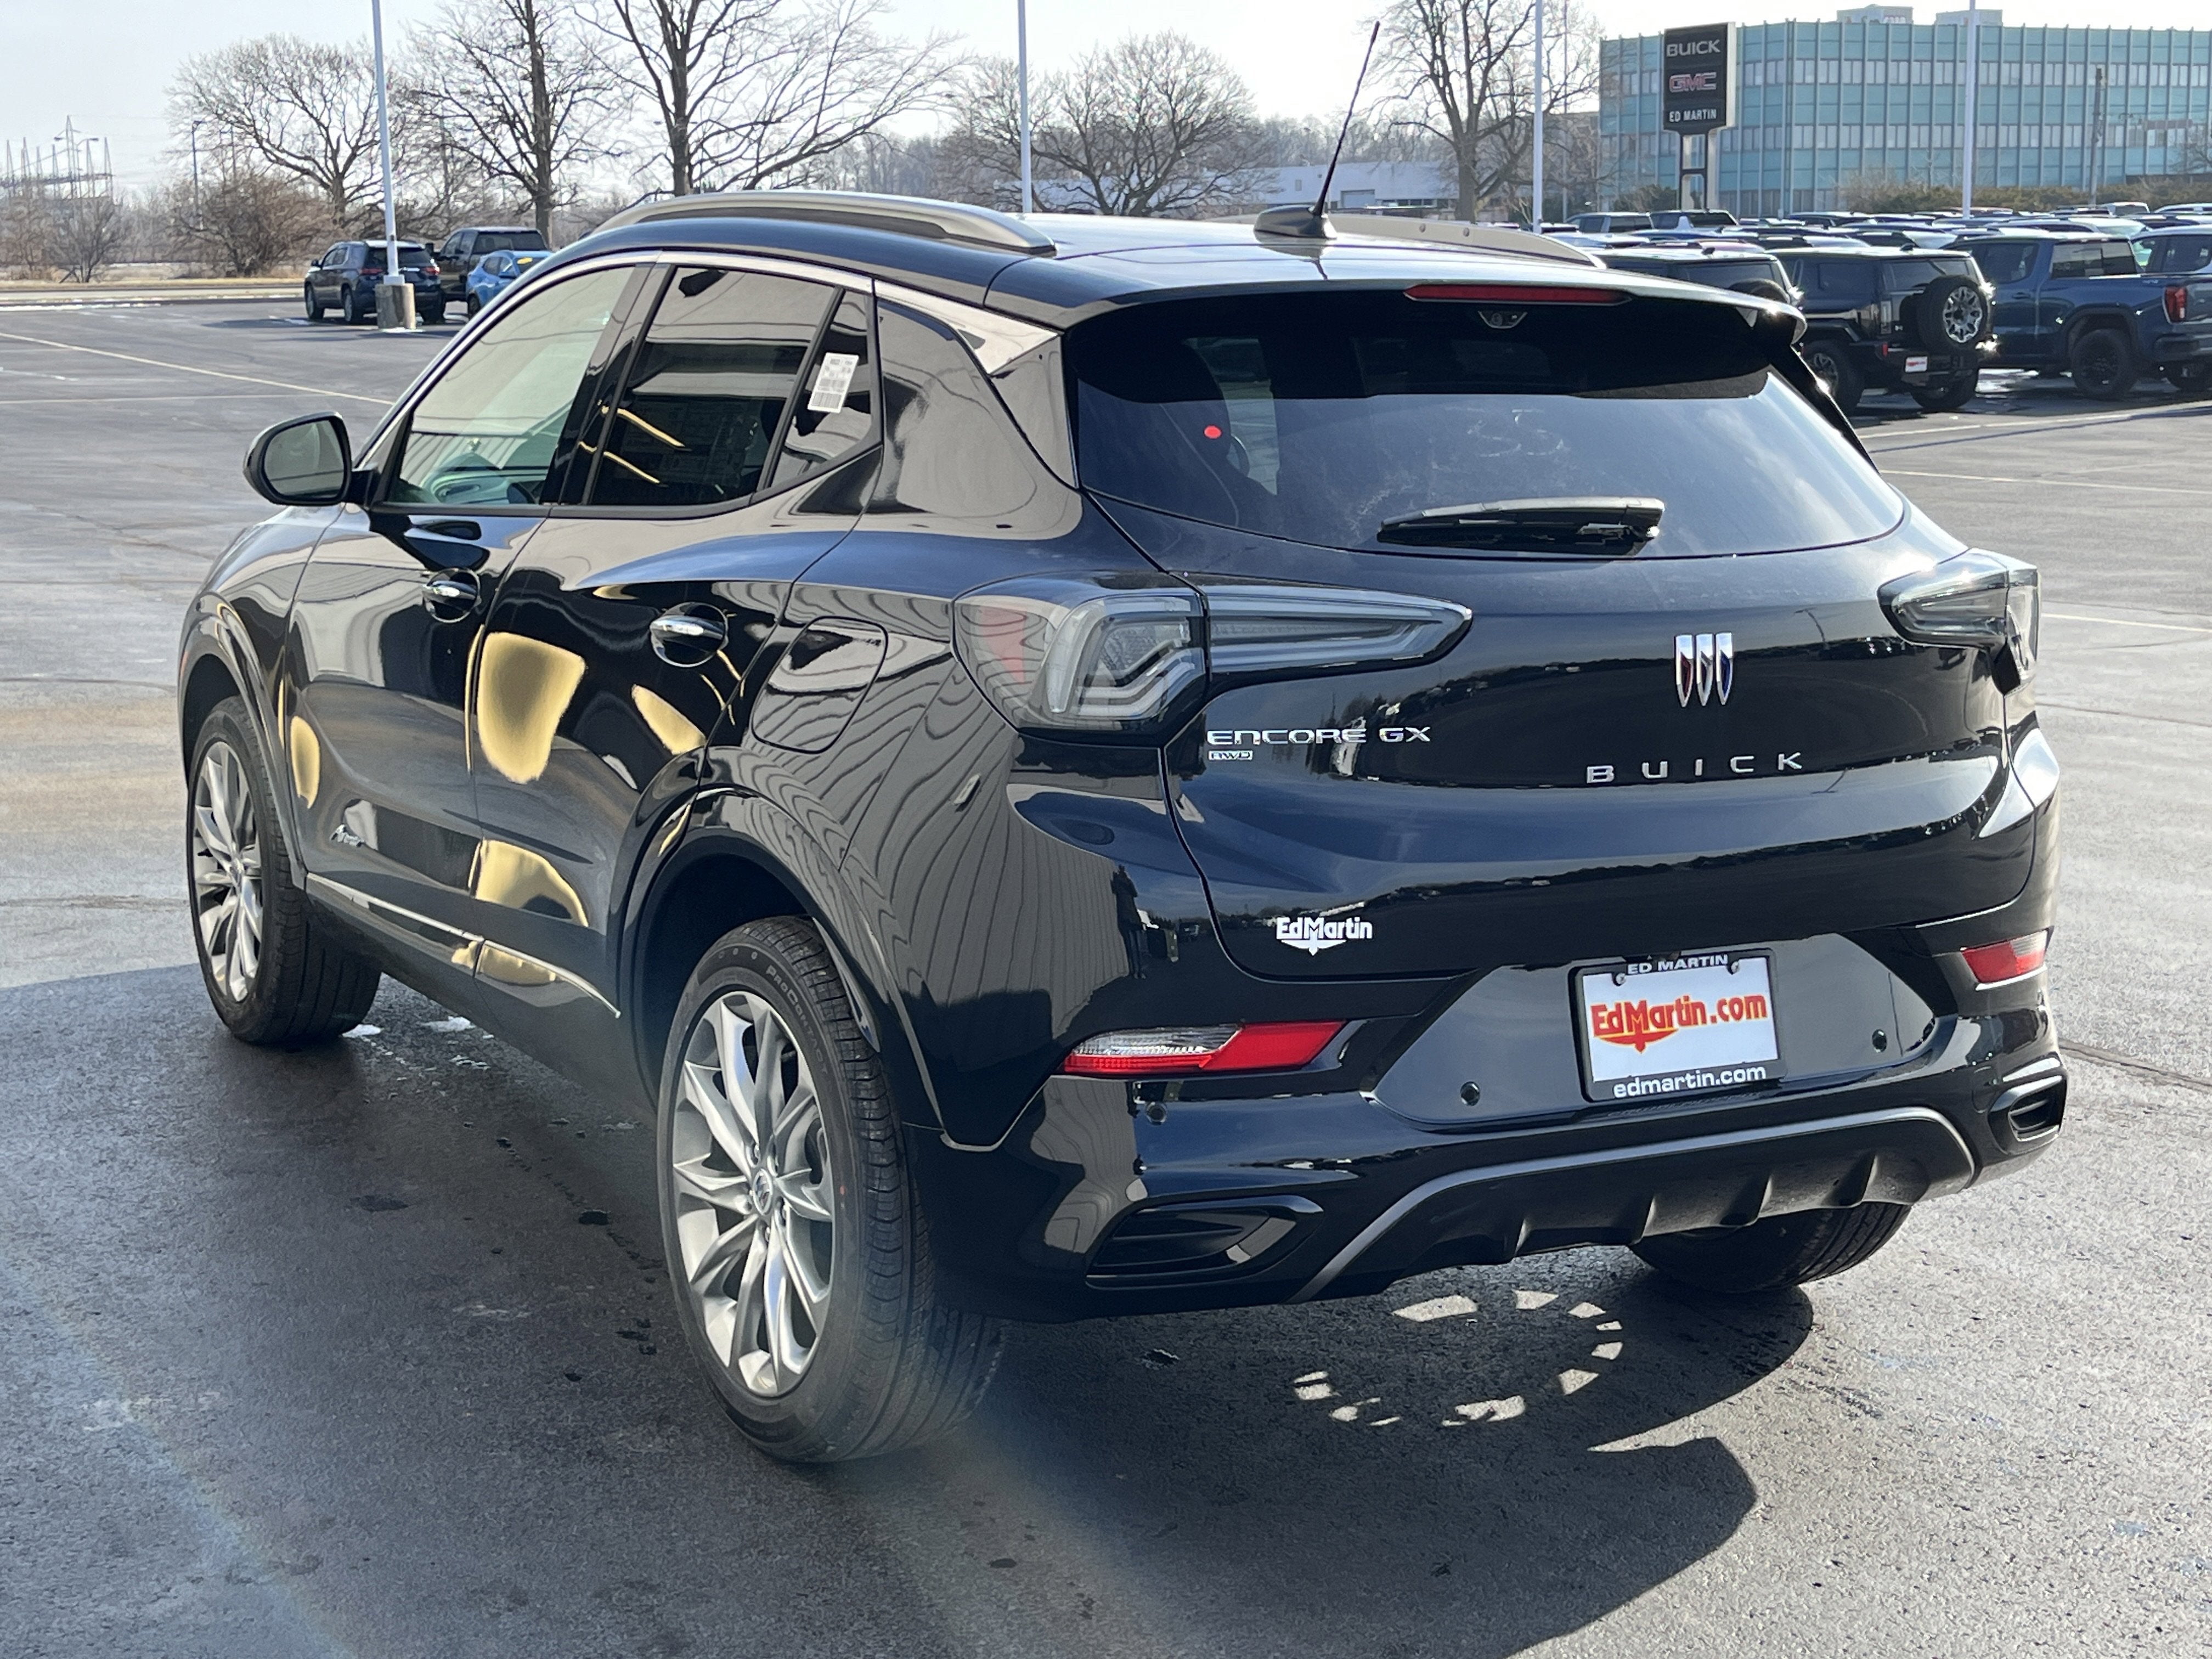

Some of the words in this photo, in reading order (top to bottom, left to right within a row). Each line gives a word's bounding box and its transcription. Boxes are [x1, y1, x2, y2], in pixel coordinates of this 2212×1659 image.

[1666, 39, 1720, 57] BUICK
[1669, 72, 1717, 93] GMC
[1669, 111, 1680, 122] ED
[1683, 109, 1717, 121] MARTIN
[1207, 728, 1367, 745] ENCORE
[1379, 726, 1431, 743] GX
[1209, 751, 1252, 760] AWD
[1587, 752, 1803, 783] BUICK
[1276, 917, 1372, 940] EdMartin
[1627, 962, 1652, 975] ED
[1657, 954, 1729, 971] MARTIN
[1613, 1065, 1767, 1098] edmartin.com
